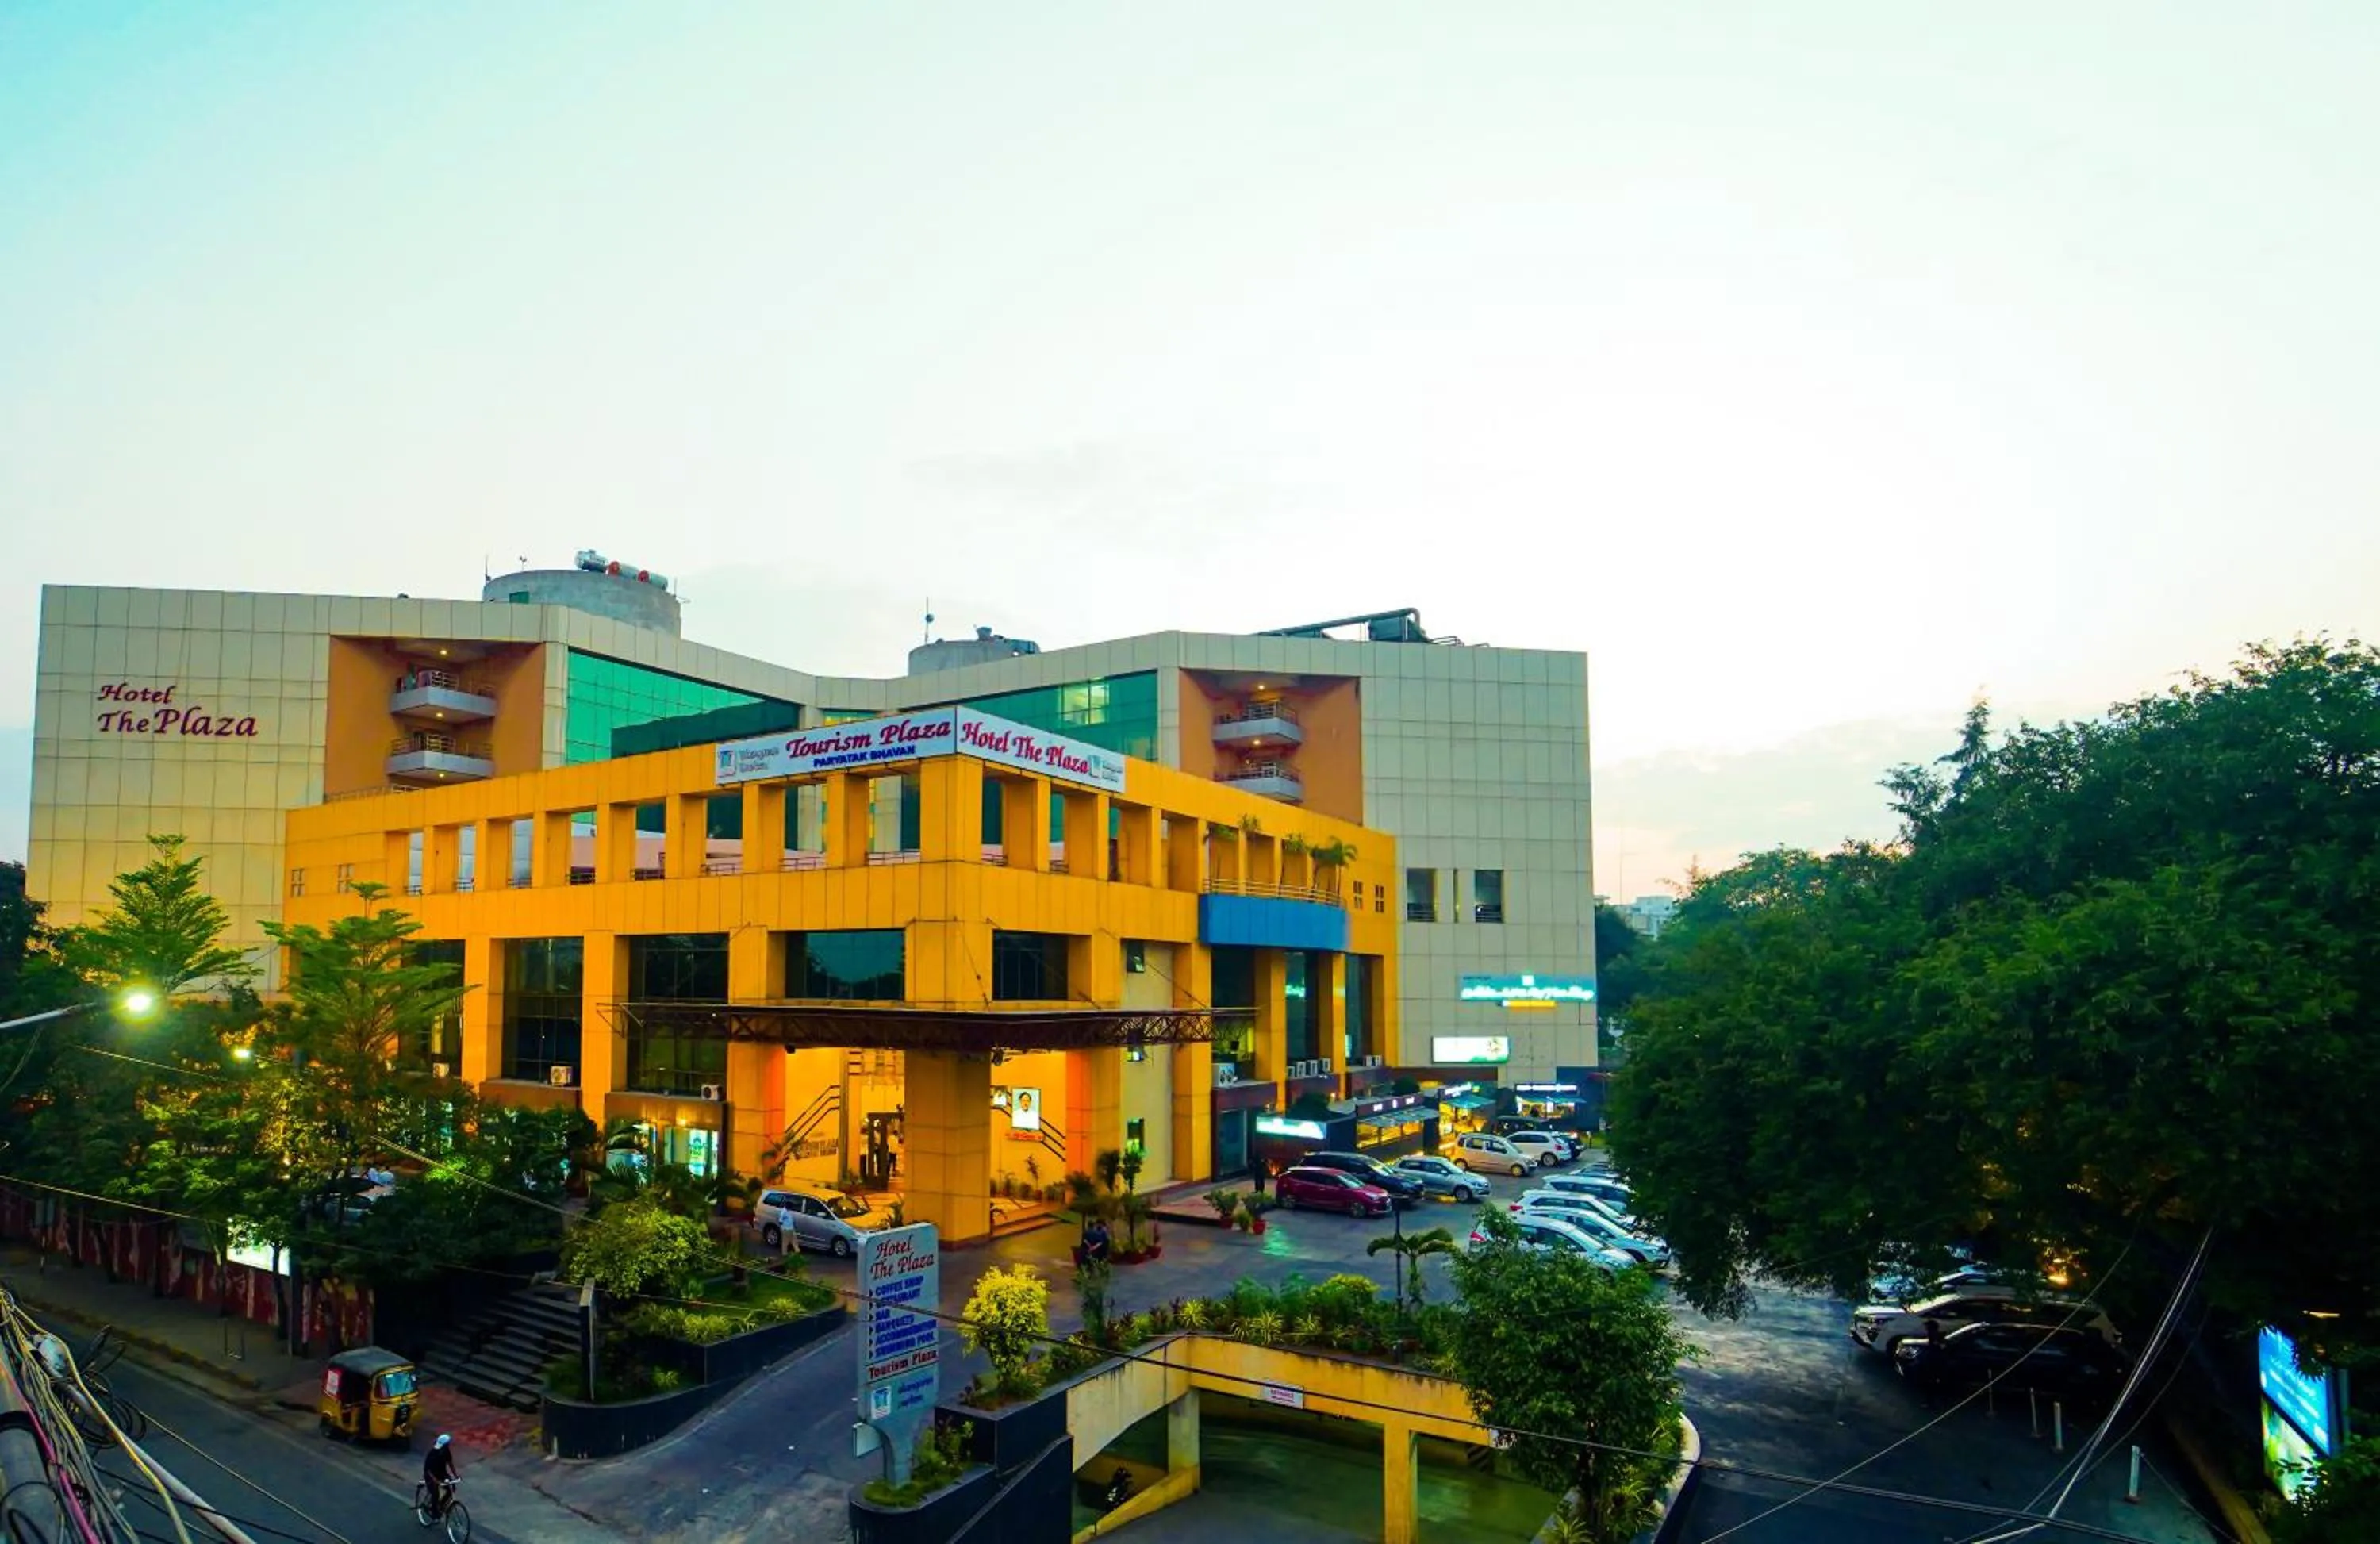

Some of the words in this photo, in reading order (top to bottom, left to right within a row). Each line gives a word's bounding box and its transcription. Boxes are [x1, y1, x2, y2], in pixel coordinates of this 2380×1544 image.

[97, 683, 178, 704] Hotel
[97, 710, 149, 733] The
[153, 705, 259, 737] Plaza
[785, 732, 872, 759] Tourism
[880, 719, 951, 746] Plaza
[959, 721, 1012, 753] Hotel
[1012, 735, 1043, 762] The
[1045, 746, 1090, 775] Plaza
[813, 750, 868, 768] PARYATAK
[870, 745, 916, 761] BHAVAN
[875, 1233, 914, 1259] Hotel
[869, 1258, 894, 1280] The
[897, 1251, 935, 1275] Plaza
[875, 1280, 903, 1296] COFFEE
[904, 1275, 924, 1289] SHOP
[869, 1358, 908, 1380] Tourism
[912, 1350, 937, 1365] Plaza
